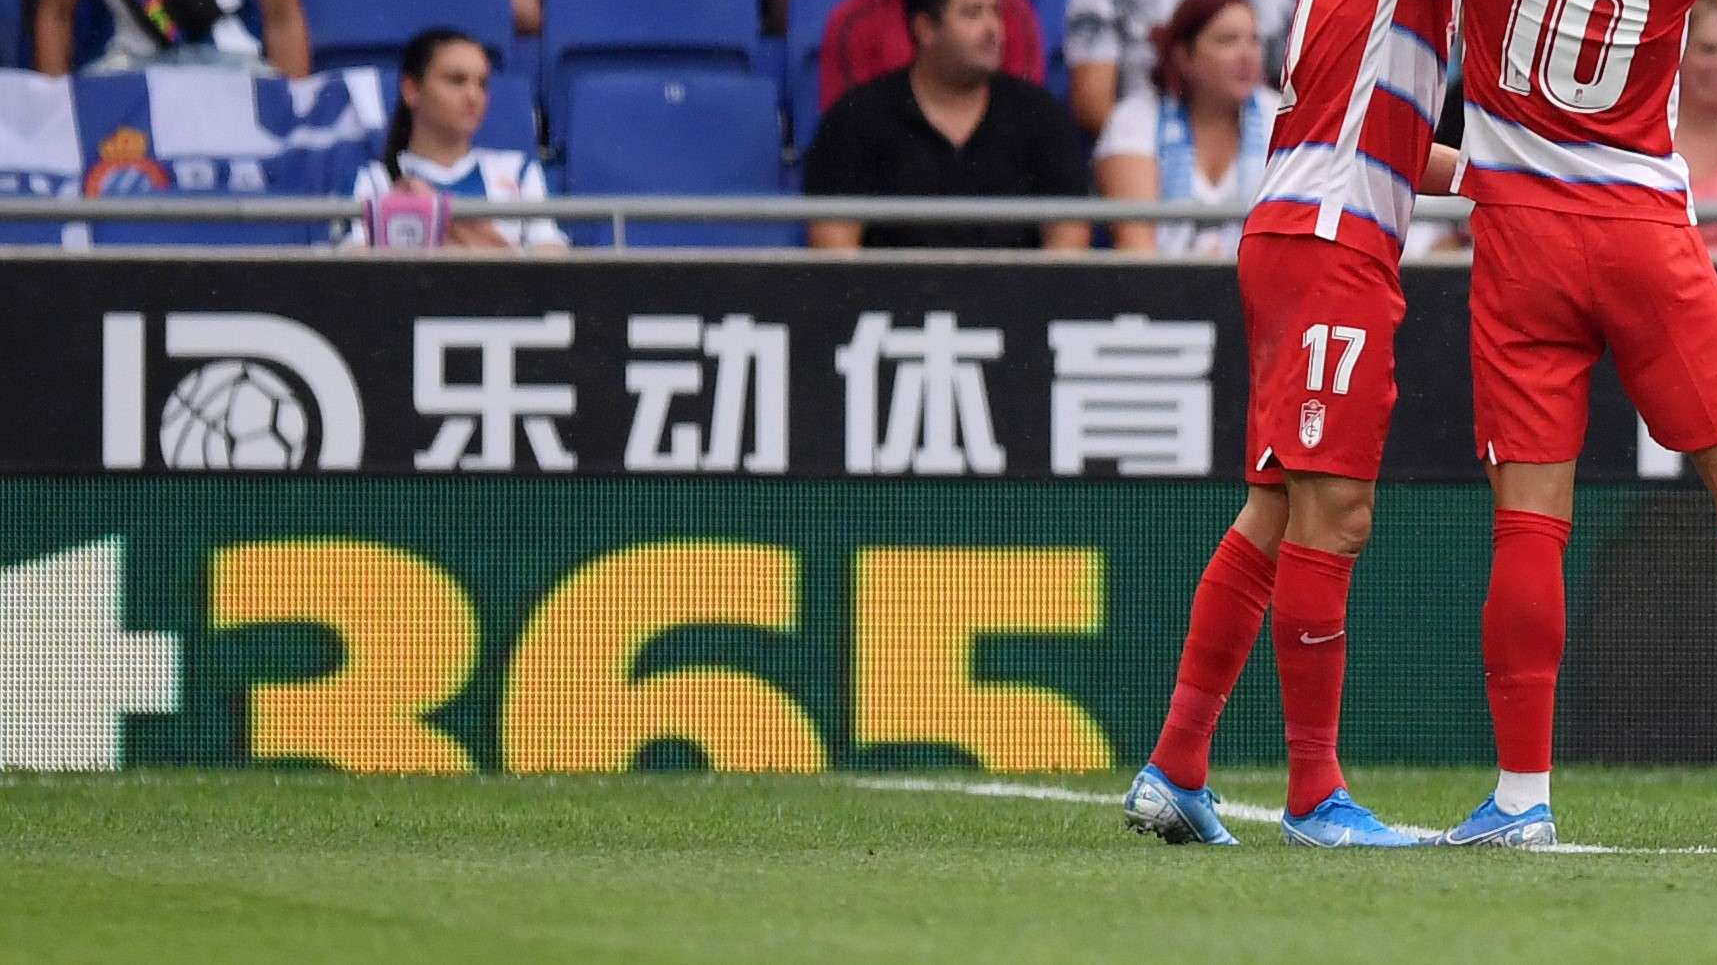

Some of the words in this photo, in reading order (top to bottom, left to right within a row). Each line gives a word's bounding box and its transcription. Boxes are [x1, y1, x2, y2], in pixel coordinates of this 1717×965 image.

[412, 310, 1216, 477] 乐动体育
[1302, 323, 1367, 395] 17
